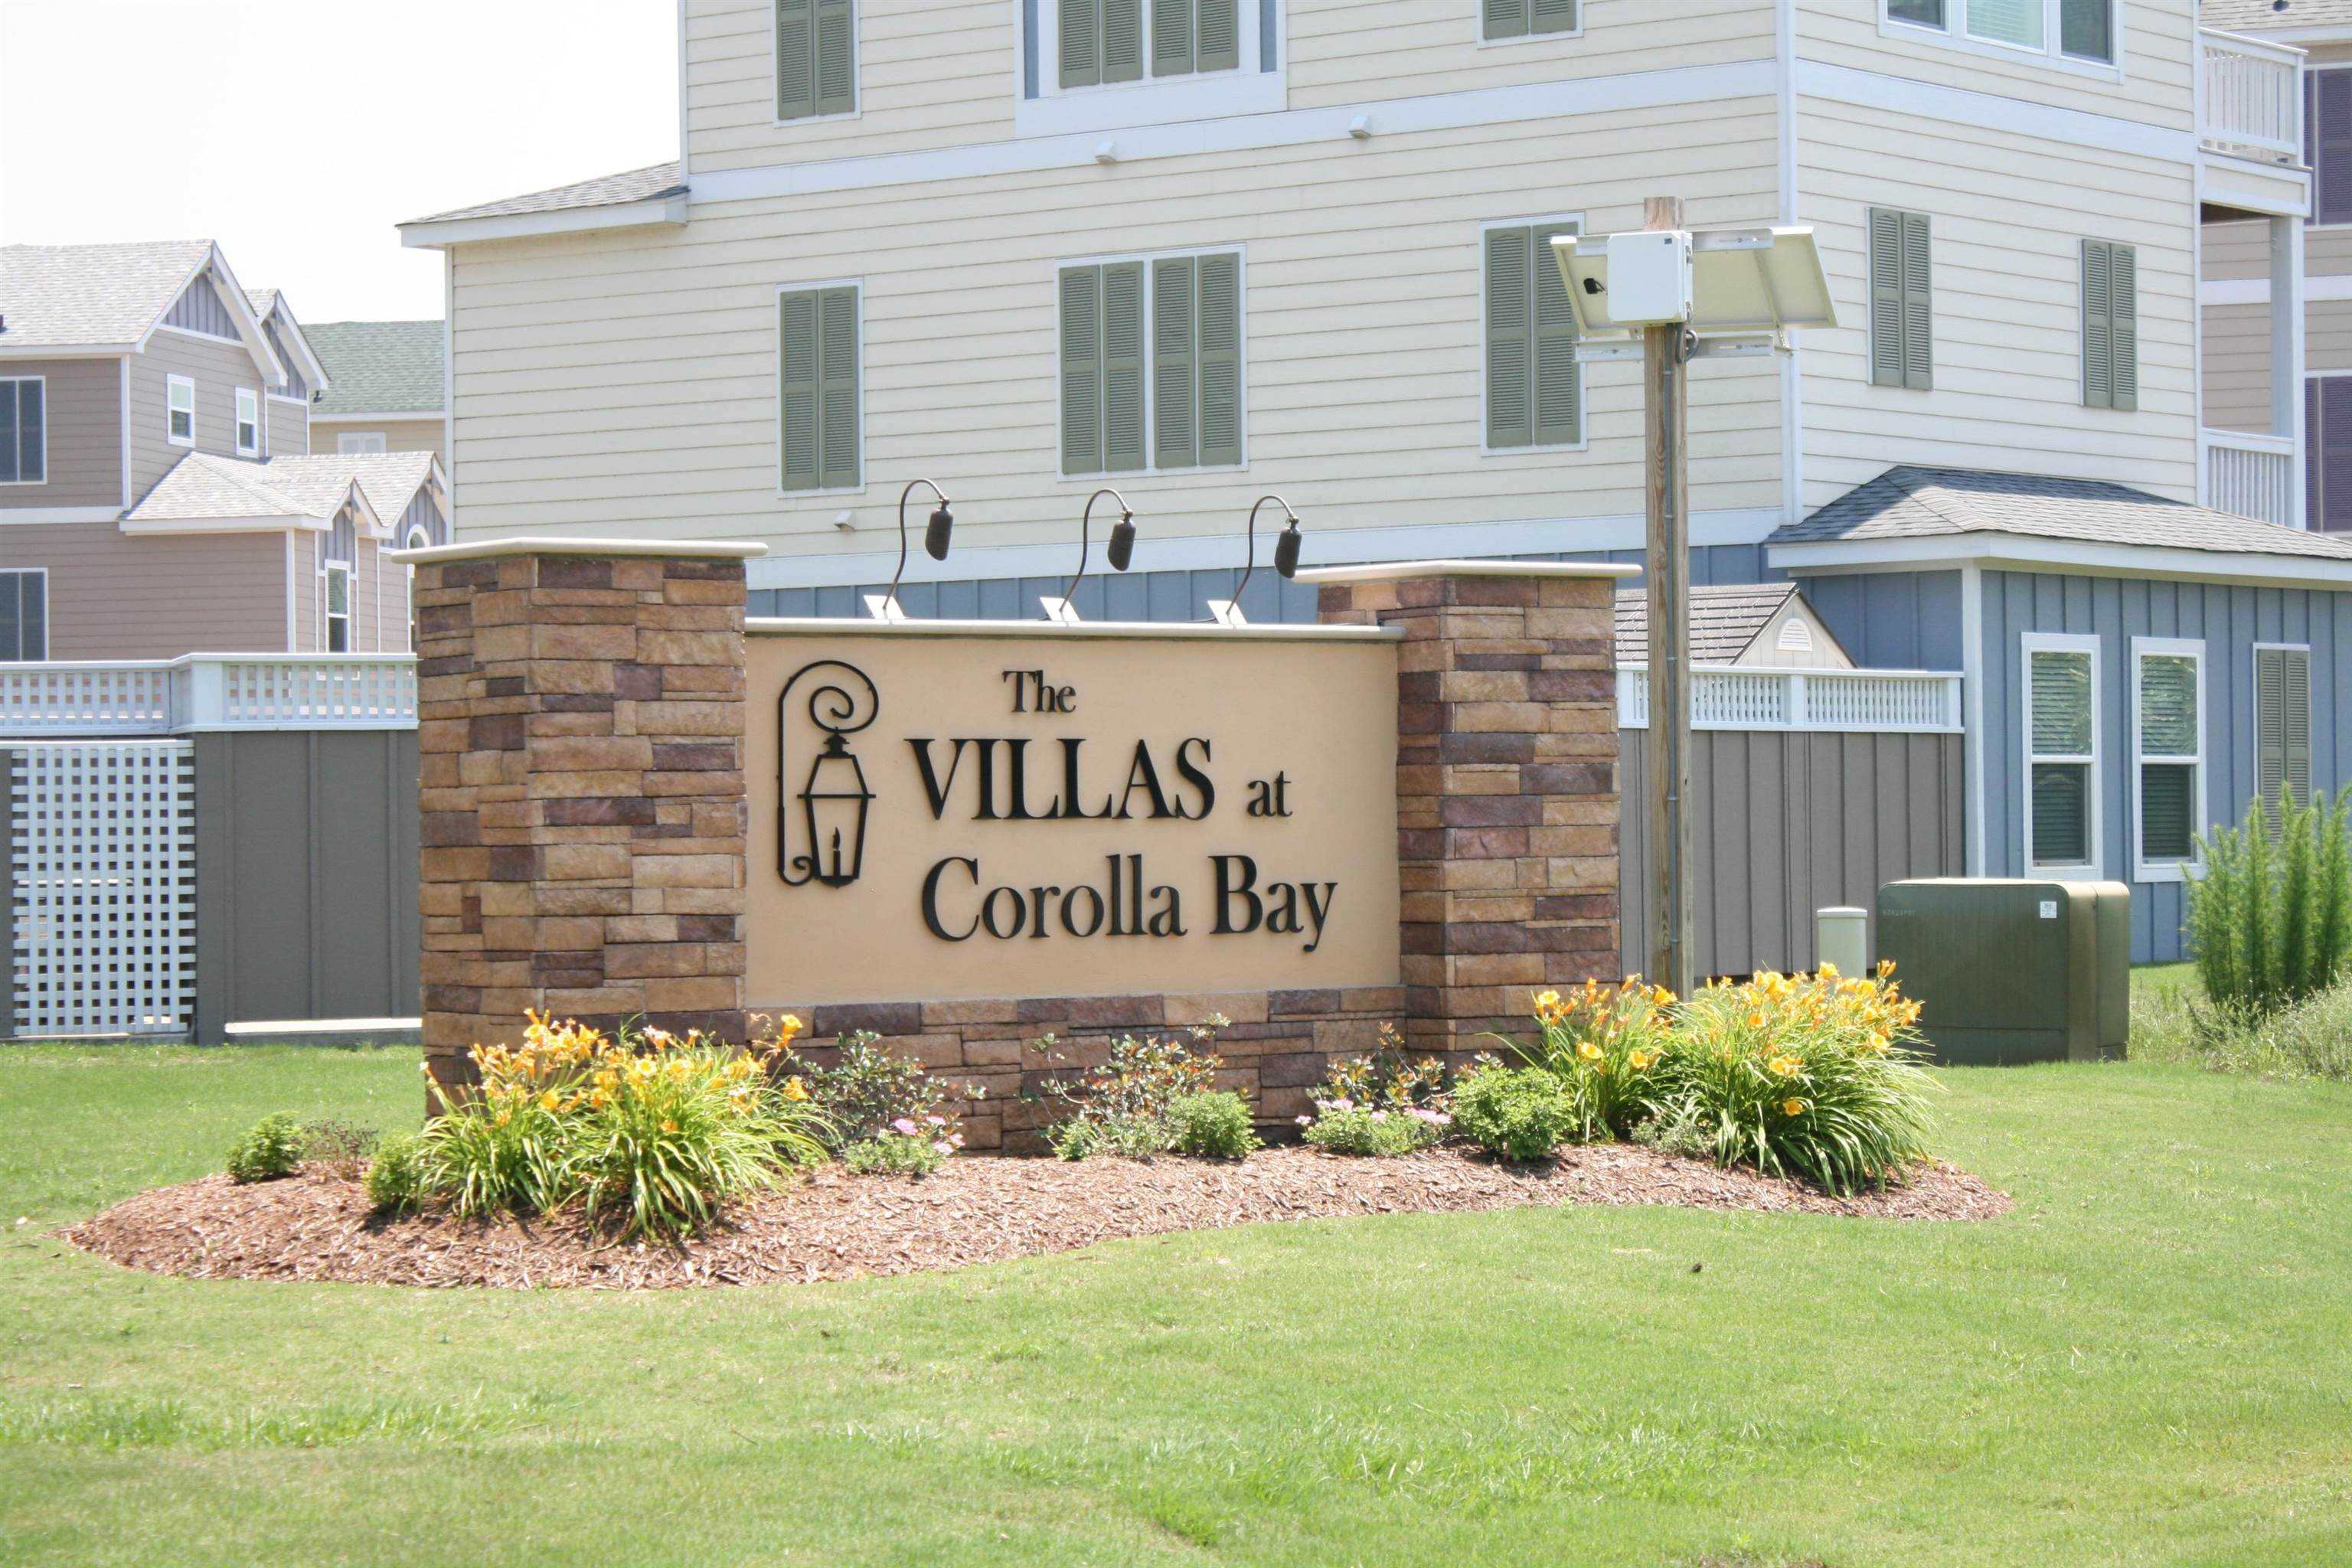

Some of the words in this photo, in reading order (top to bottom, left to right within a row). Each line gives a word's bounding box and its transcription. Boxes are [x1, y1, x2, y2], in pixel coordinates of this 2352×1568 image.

[1002, 669, 1076, 714] The
[903, 737, 1215, 821] VILLAS
[1246, 770, 1293, 818] at
[920, 854, 1188, 942] Corolla
[1208, 854, 1338, 954] Bay
